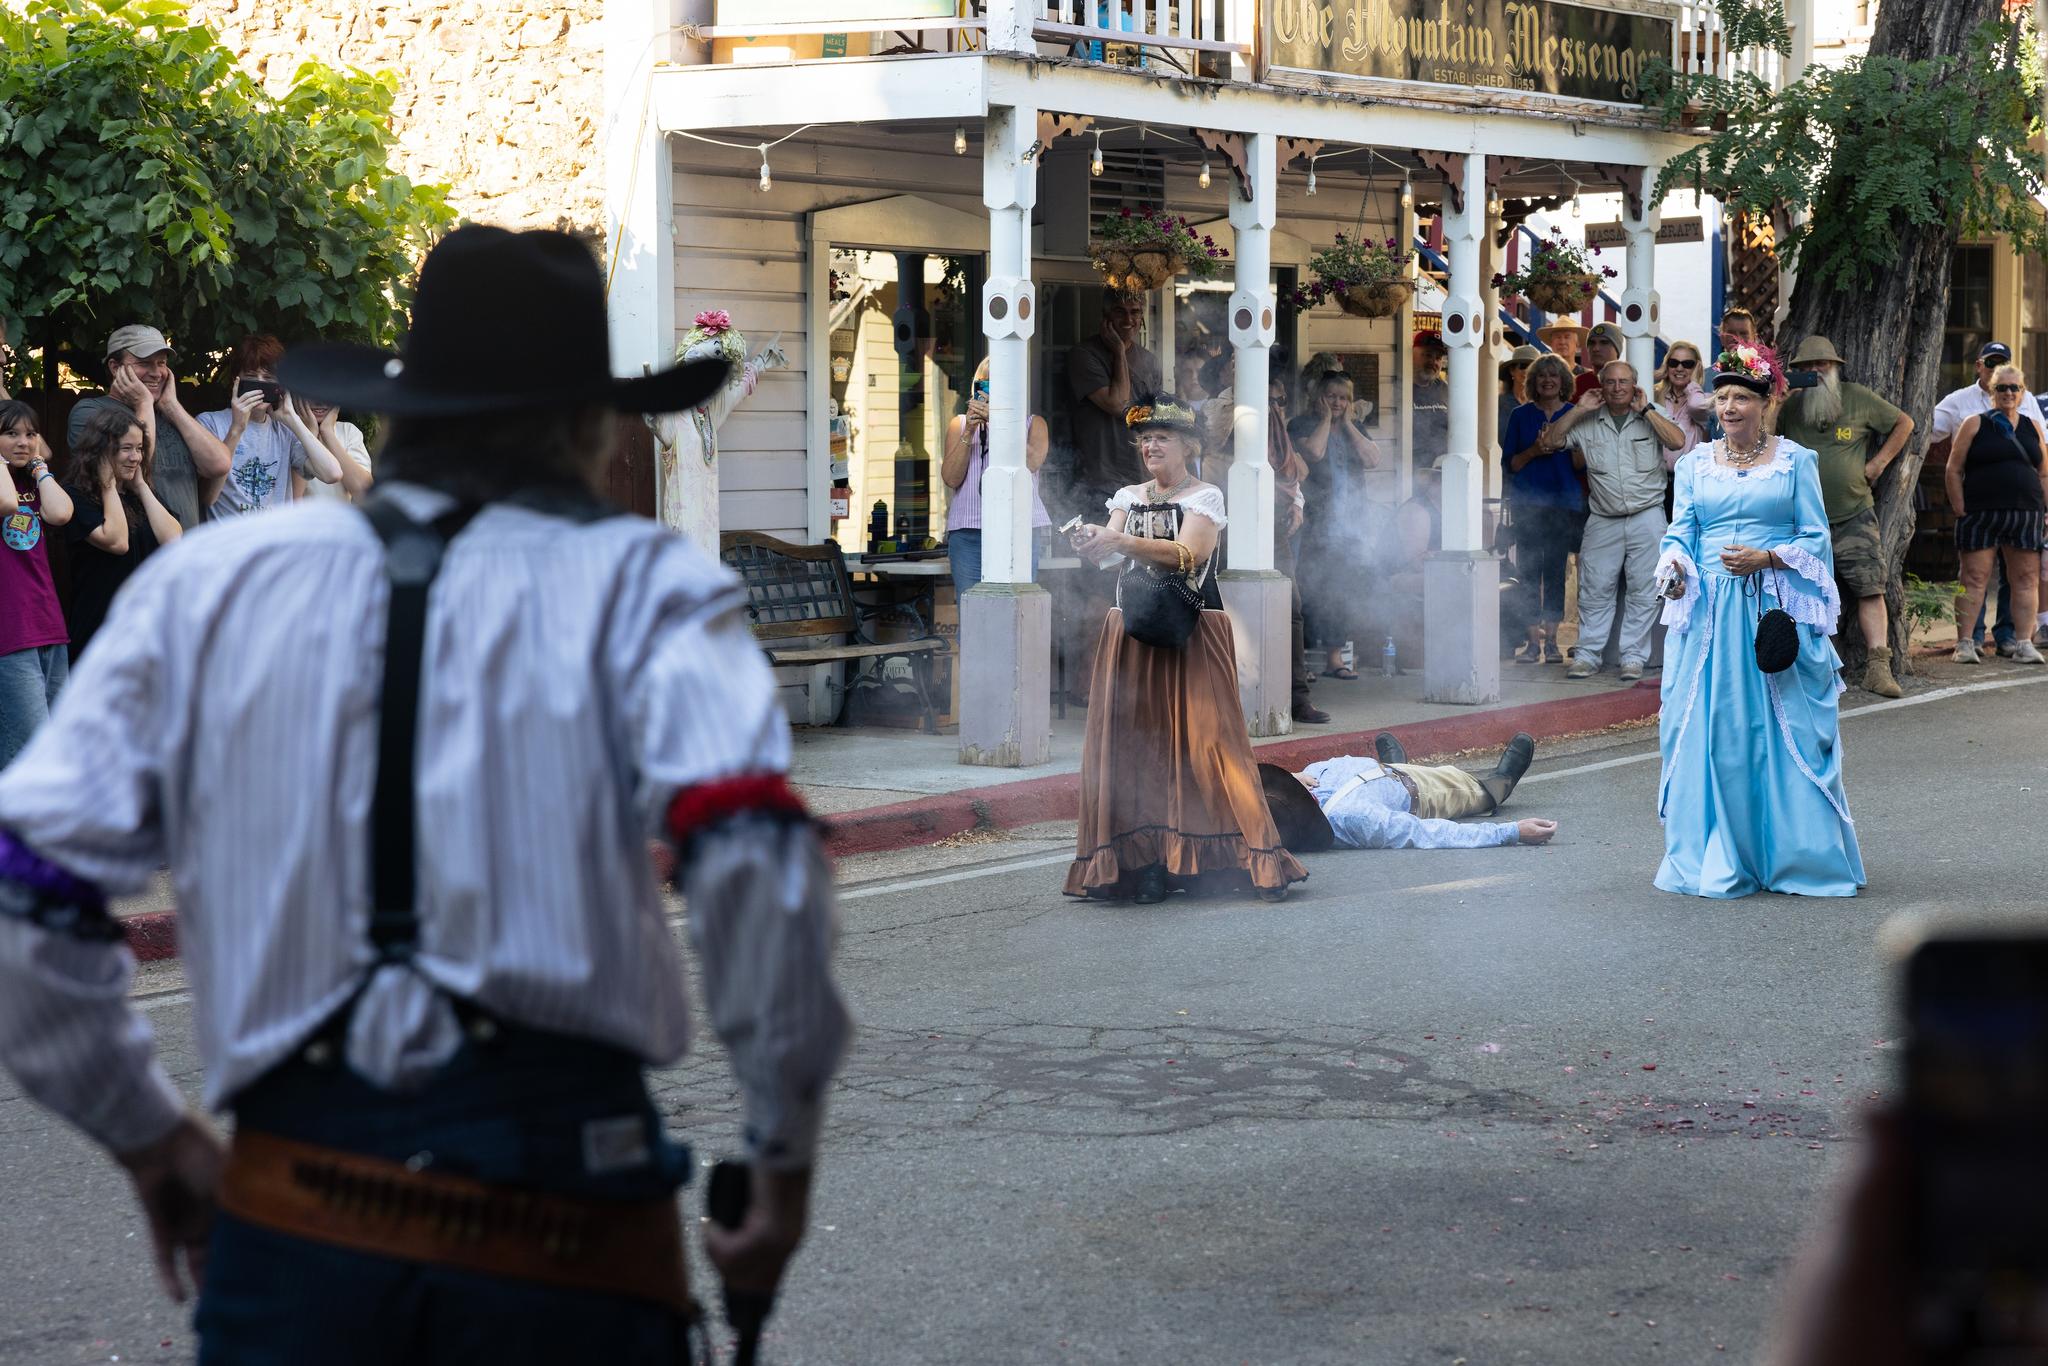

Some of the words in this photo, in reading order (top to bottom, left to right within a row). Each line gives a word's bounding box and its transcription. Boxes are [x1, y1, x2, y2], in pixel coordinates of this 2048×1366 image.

[825, 37, 846, 47] MEALS
[1273, 0, 1334, 49] The
[1342, 0, 1495, 68] Mountain
[1434, 68, 1505, 88] ESTABLISHED
[1513, 77, 1536, 92] 1853
[1587, 228, 1626, 244] MASSA
[1656, 221, 1701, 239] ERAPY
